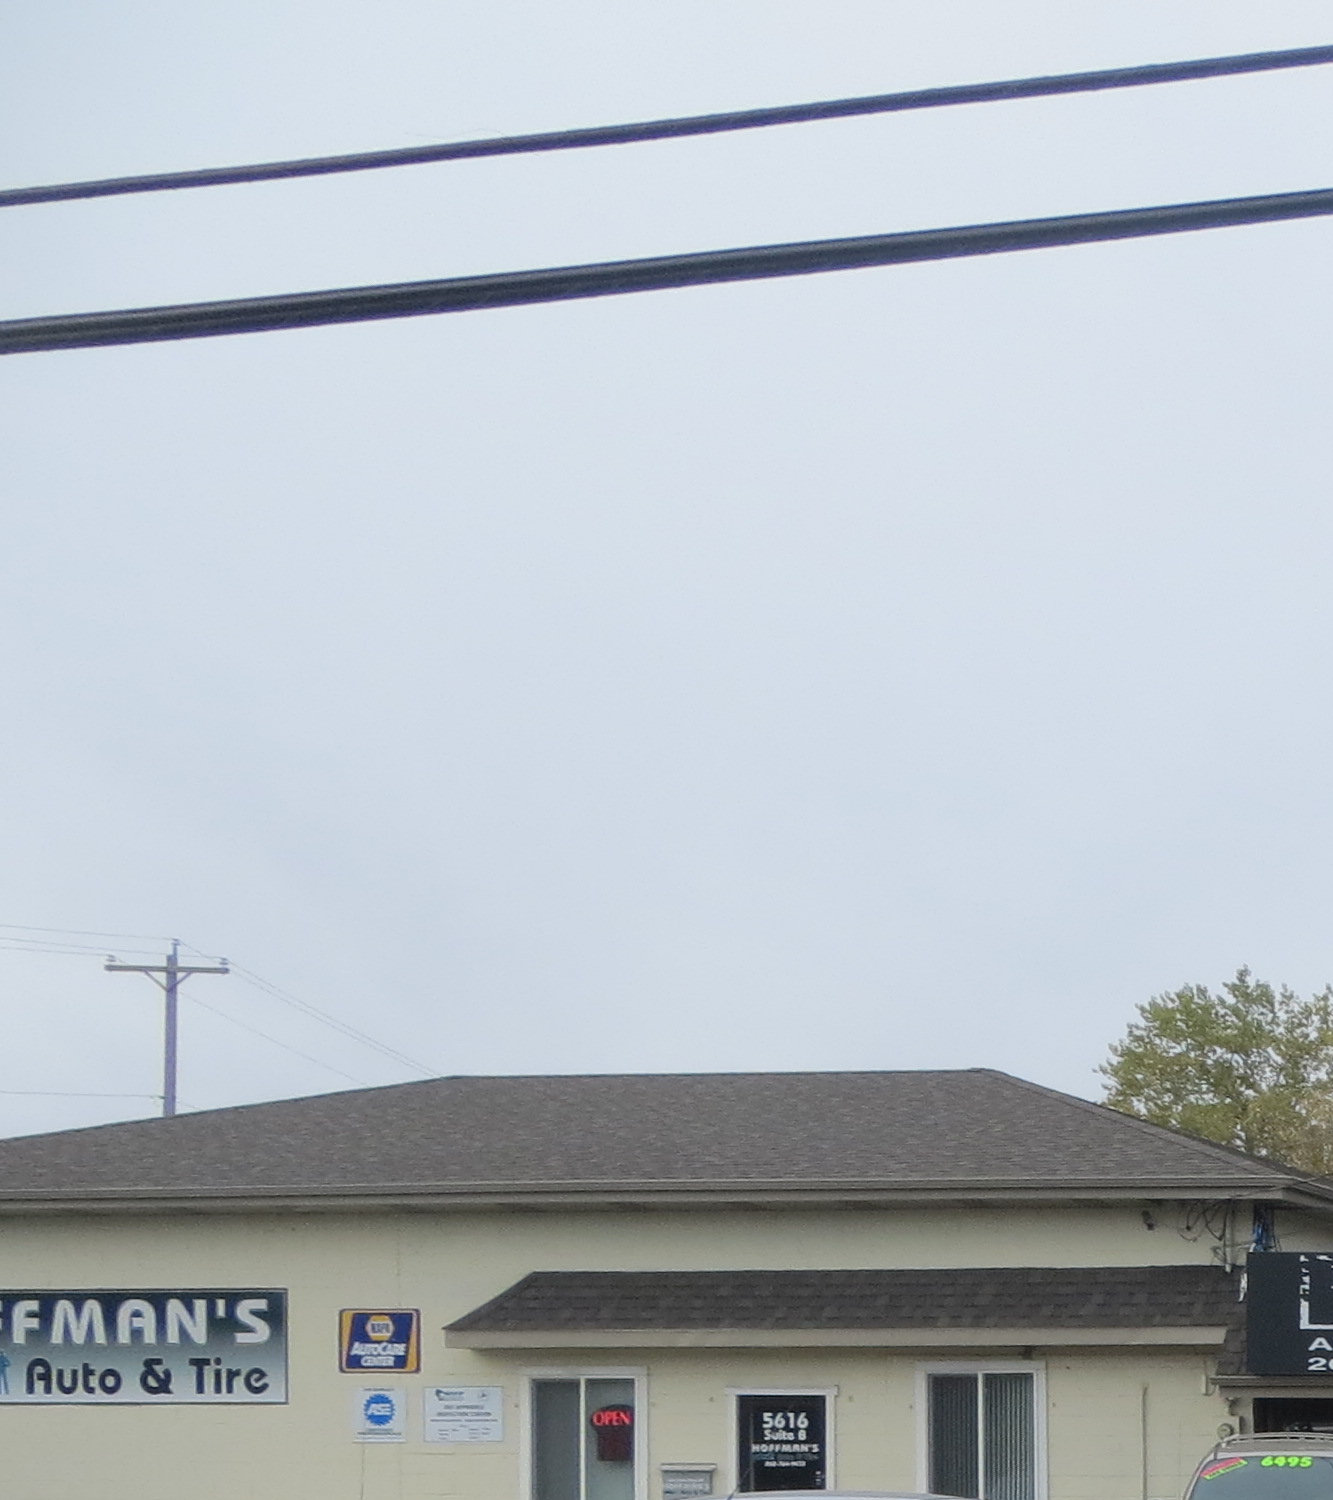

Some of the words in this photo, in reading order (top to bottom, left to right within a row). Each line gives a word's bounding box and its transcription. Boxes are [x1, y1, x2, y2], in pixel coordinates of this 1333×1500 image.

[0, 1298, 271, 1345] FMAN'S
[26, 1357, 122, 1395] Auto
[139, 1357, 174, 1395] &
[189, 1356, 269, 1395] Tire
[592, 1410, 632, 1426] OPEN
[762, 1412, 809, 1429] 5616
[763, 1429, 795, 1441] Suite
[798, 1429, 807, 1441] B
[751, 1443, 820, 1453] HOFFMAN'S
[1261, 1456, 1314, 1468] 6495
